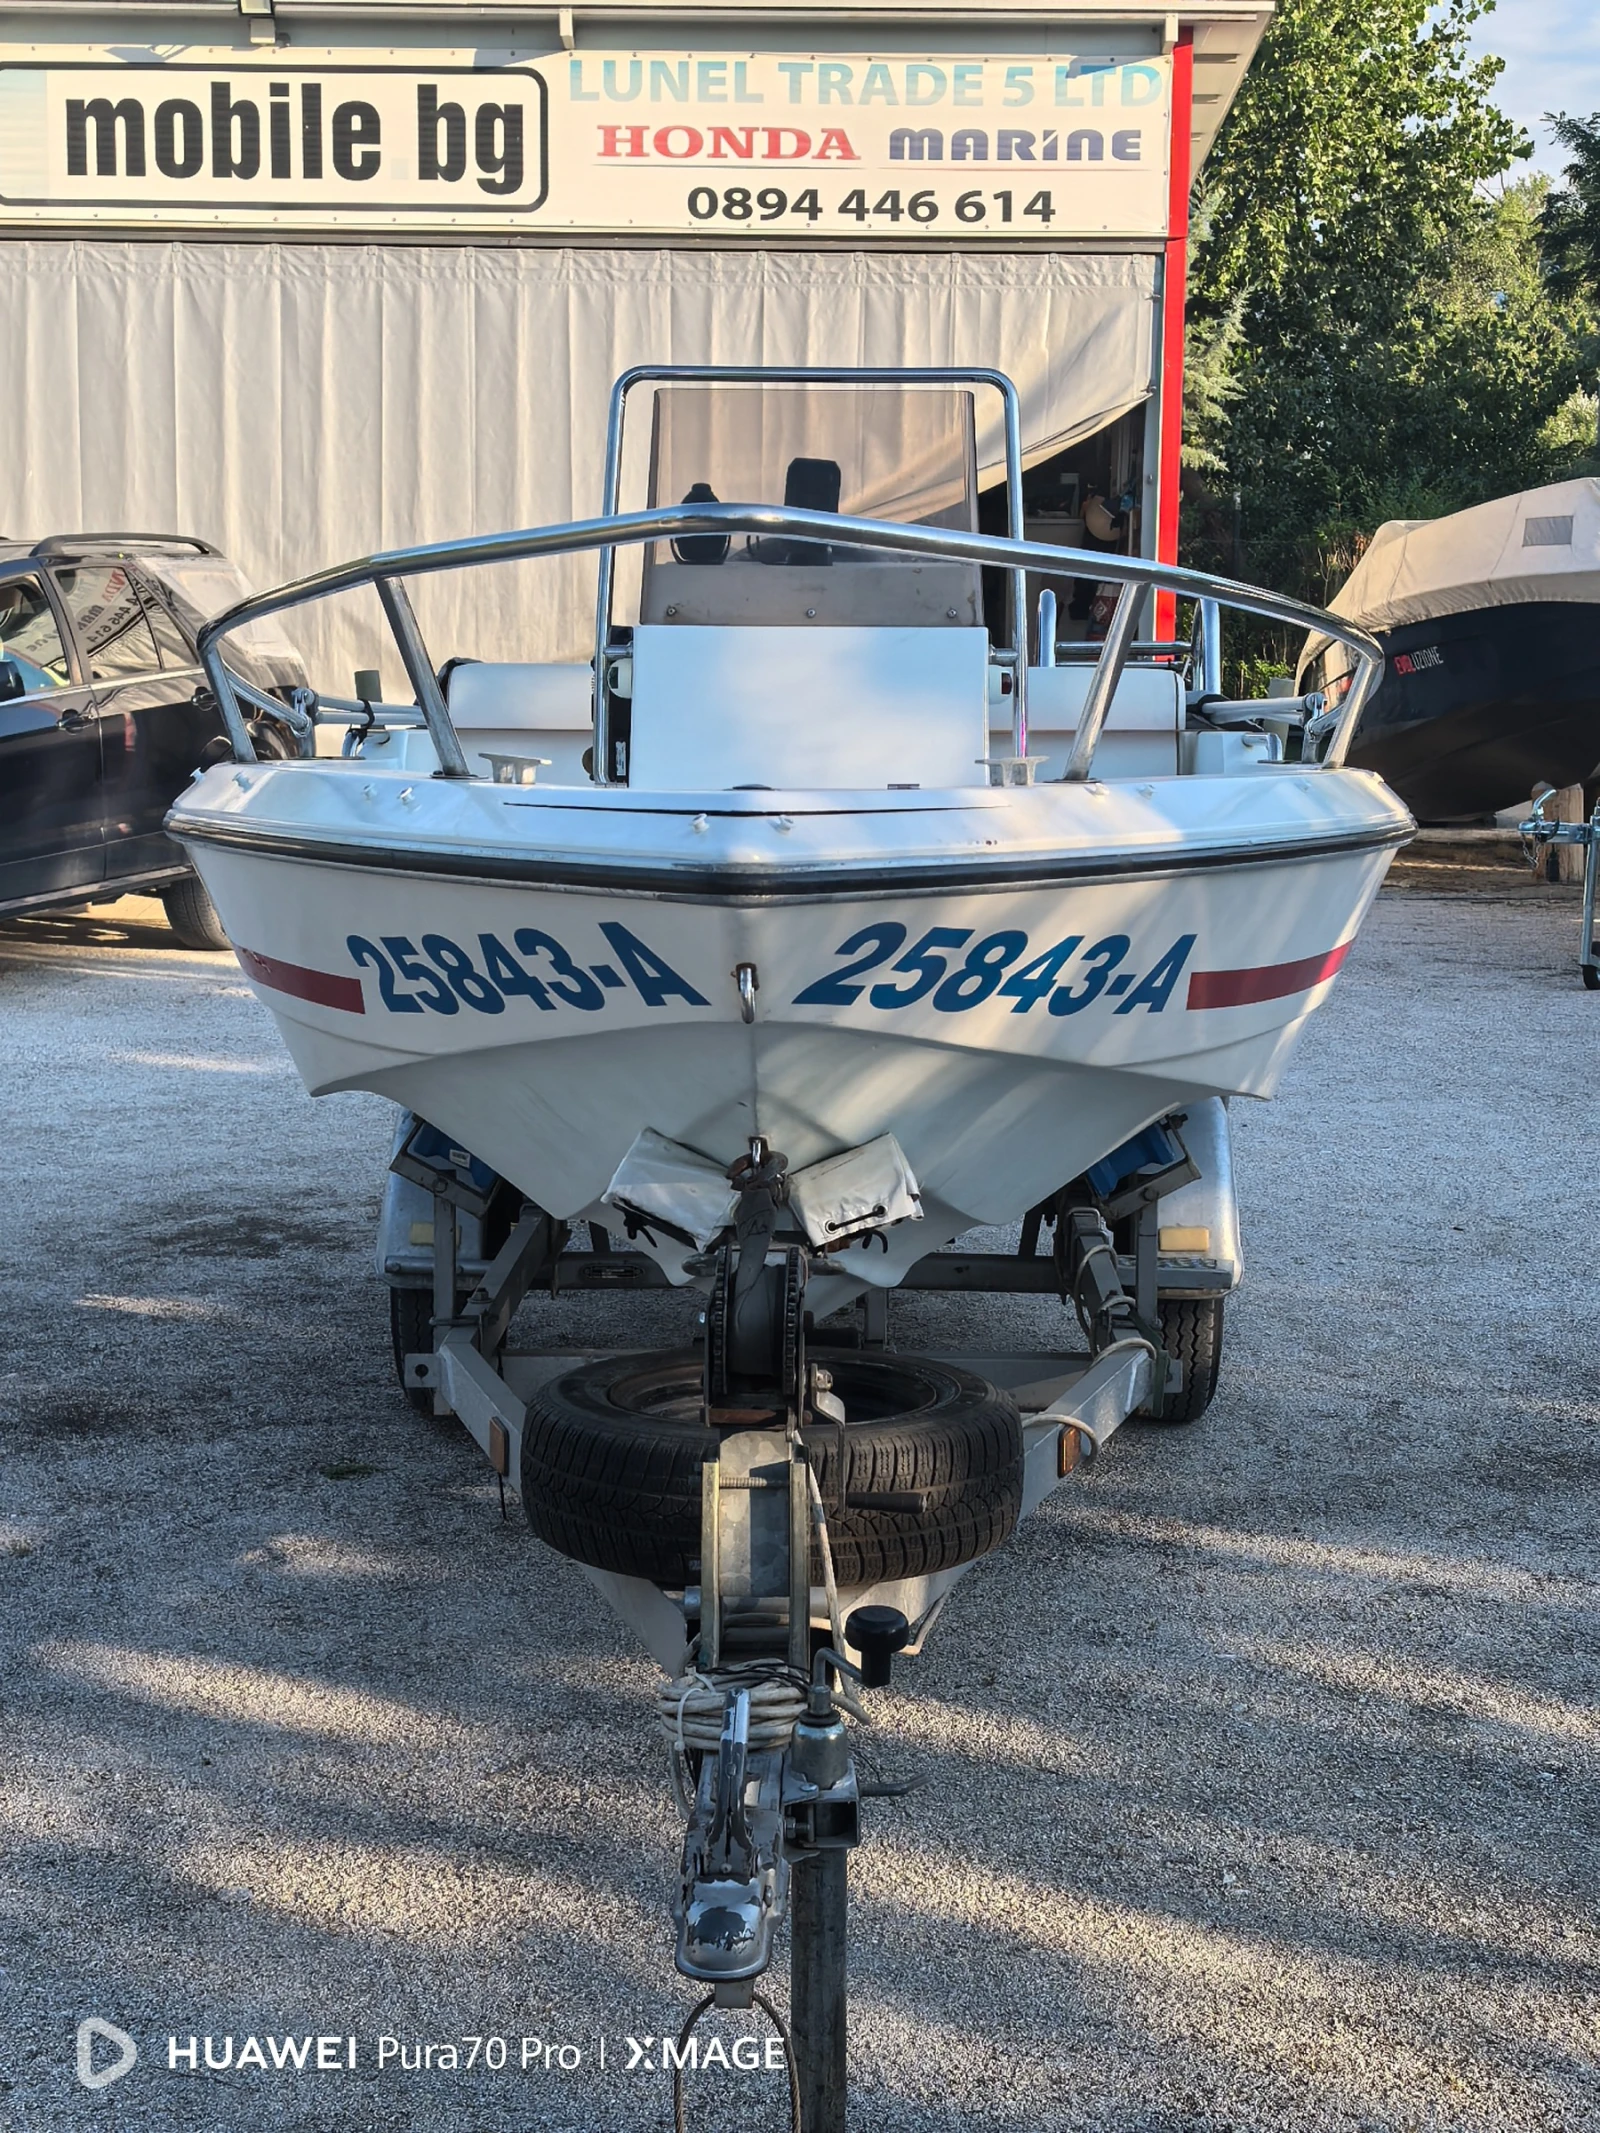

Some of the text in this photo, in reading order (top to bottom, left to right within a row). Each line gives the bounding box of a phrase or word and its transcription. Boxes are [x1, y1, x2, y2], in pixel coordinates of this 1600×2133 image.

[569, 59, 1163, 107] LUNEL TRADE 5 LTD
[66, 81, 523, 195] mobile bg
[596, 125, 861, 161] HONDA
[687, 186, 1056, 223] 0894 446 614
[346, 921, 712, 1016] 25843-A
[791, 921, 1198, 1017] 25843-A
